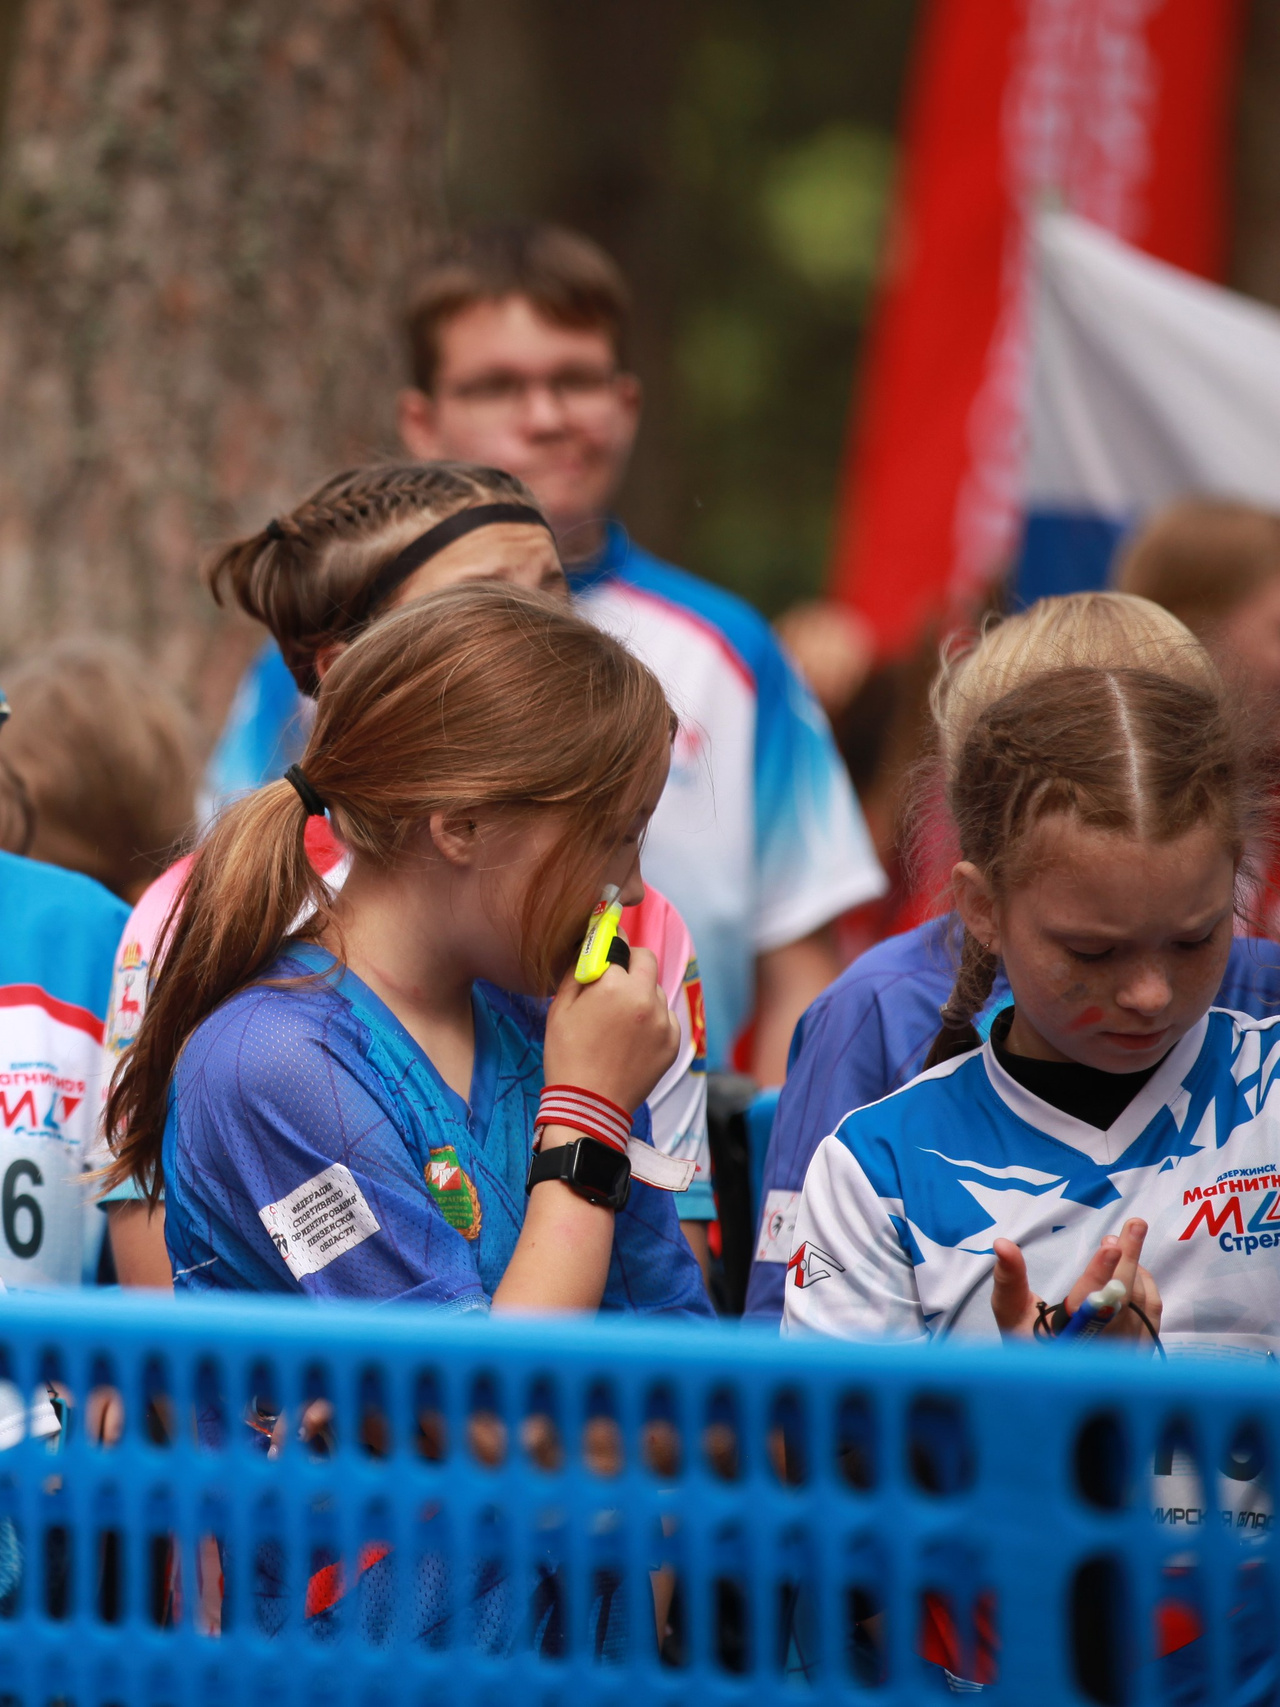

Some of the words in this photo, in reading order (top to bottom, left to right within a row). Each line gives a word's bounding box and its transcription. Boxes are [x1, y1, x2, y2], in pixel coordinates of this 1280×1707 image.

[1215, 1163, 1277, 1184] ДЗЕРЖИНСК
[291, 1182, 334, 1214] ФЕДЕРАЦИЯ
[292, 1189, 345, 1228] СПОРТИВНОГО
[291, 1196, 358, 1242] ОРИЕНТИРОВАНИЯ
[307, 1210, 356, 1248] ПЕНЗЕНСКОЙ
[319, 1225, 357, 1253] ОБЛАСТИ
